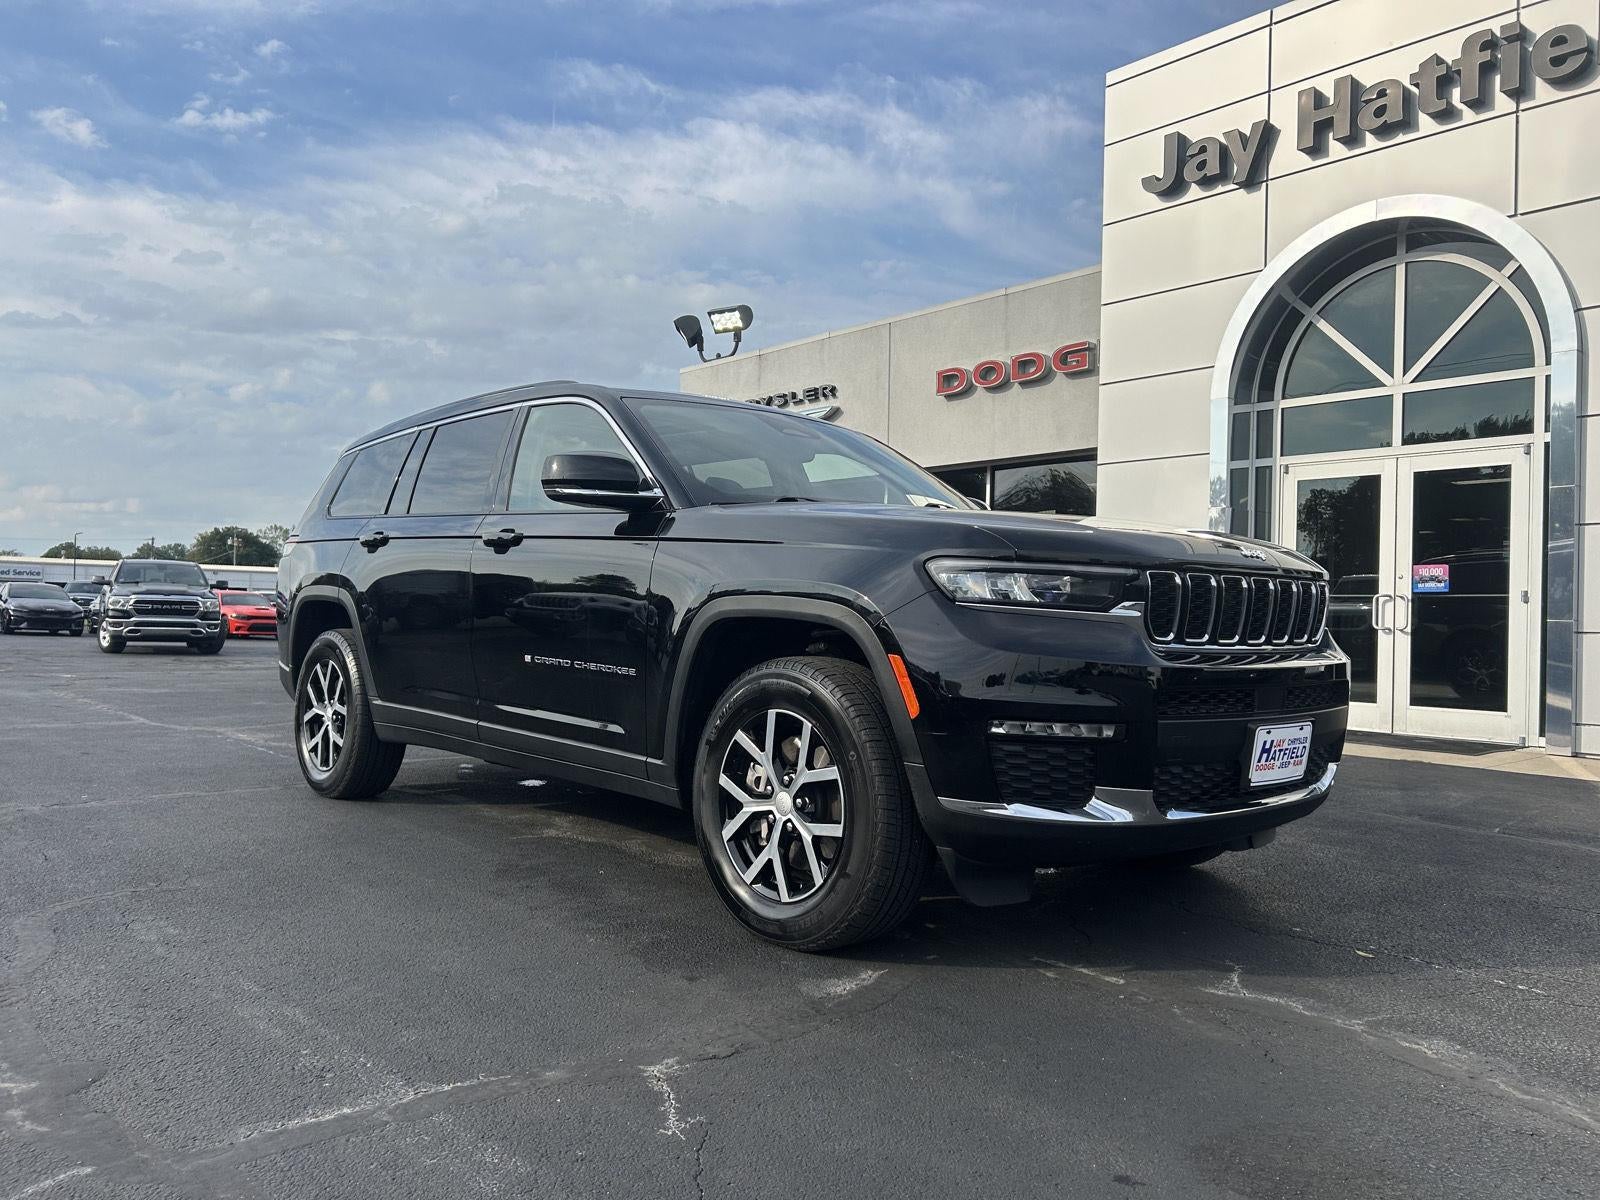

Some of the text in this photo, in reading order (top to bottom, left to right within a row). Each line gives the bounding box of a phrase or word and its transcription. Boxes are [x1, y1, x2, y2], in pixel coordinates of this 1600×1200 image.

[1142, 20, 1590, 194] Jay Hatfie
[936, 340, 1100, 396] DODG
[12, 568, 41, 577] Service
[533, 655, 637, 676] GRAND CHEROKEE
[1257, 740, 1306, 763] HATFIELD
[1274, 736, 1308, 748] JAY CHRYSLER
[1255, 759, 1303, 772] DODGE JEEP RAM
